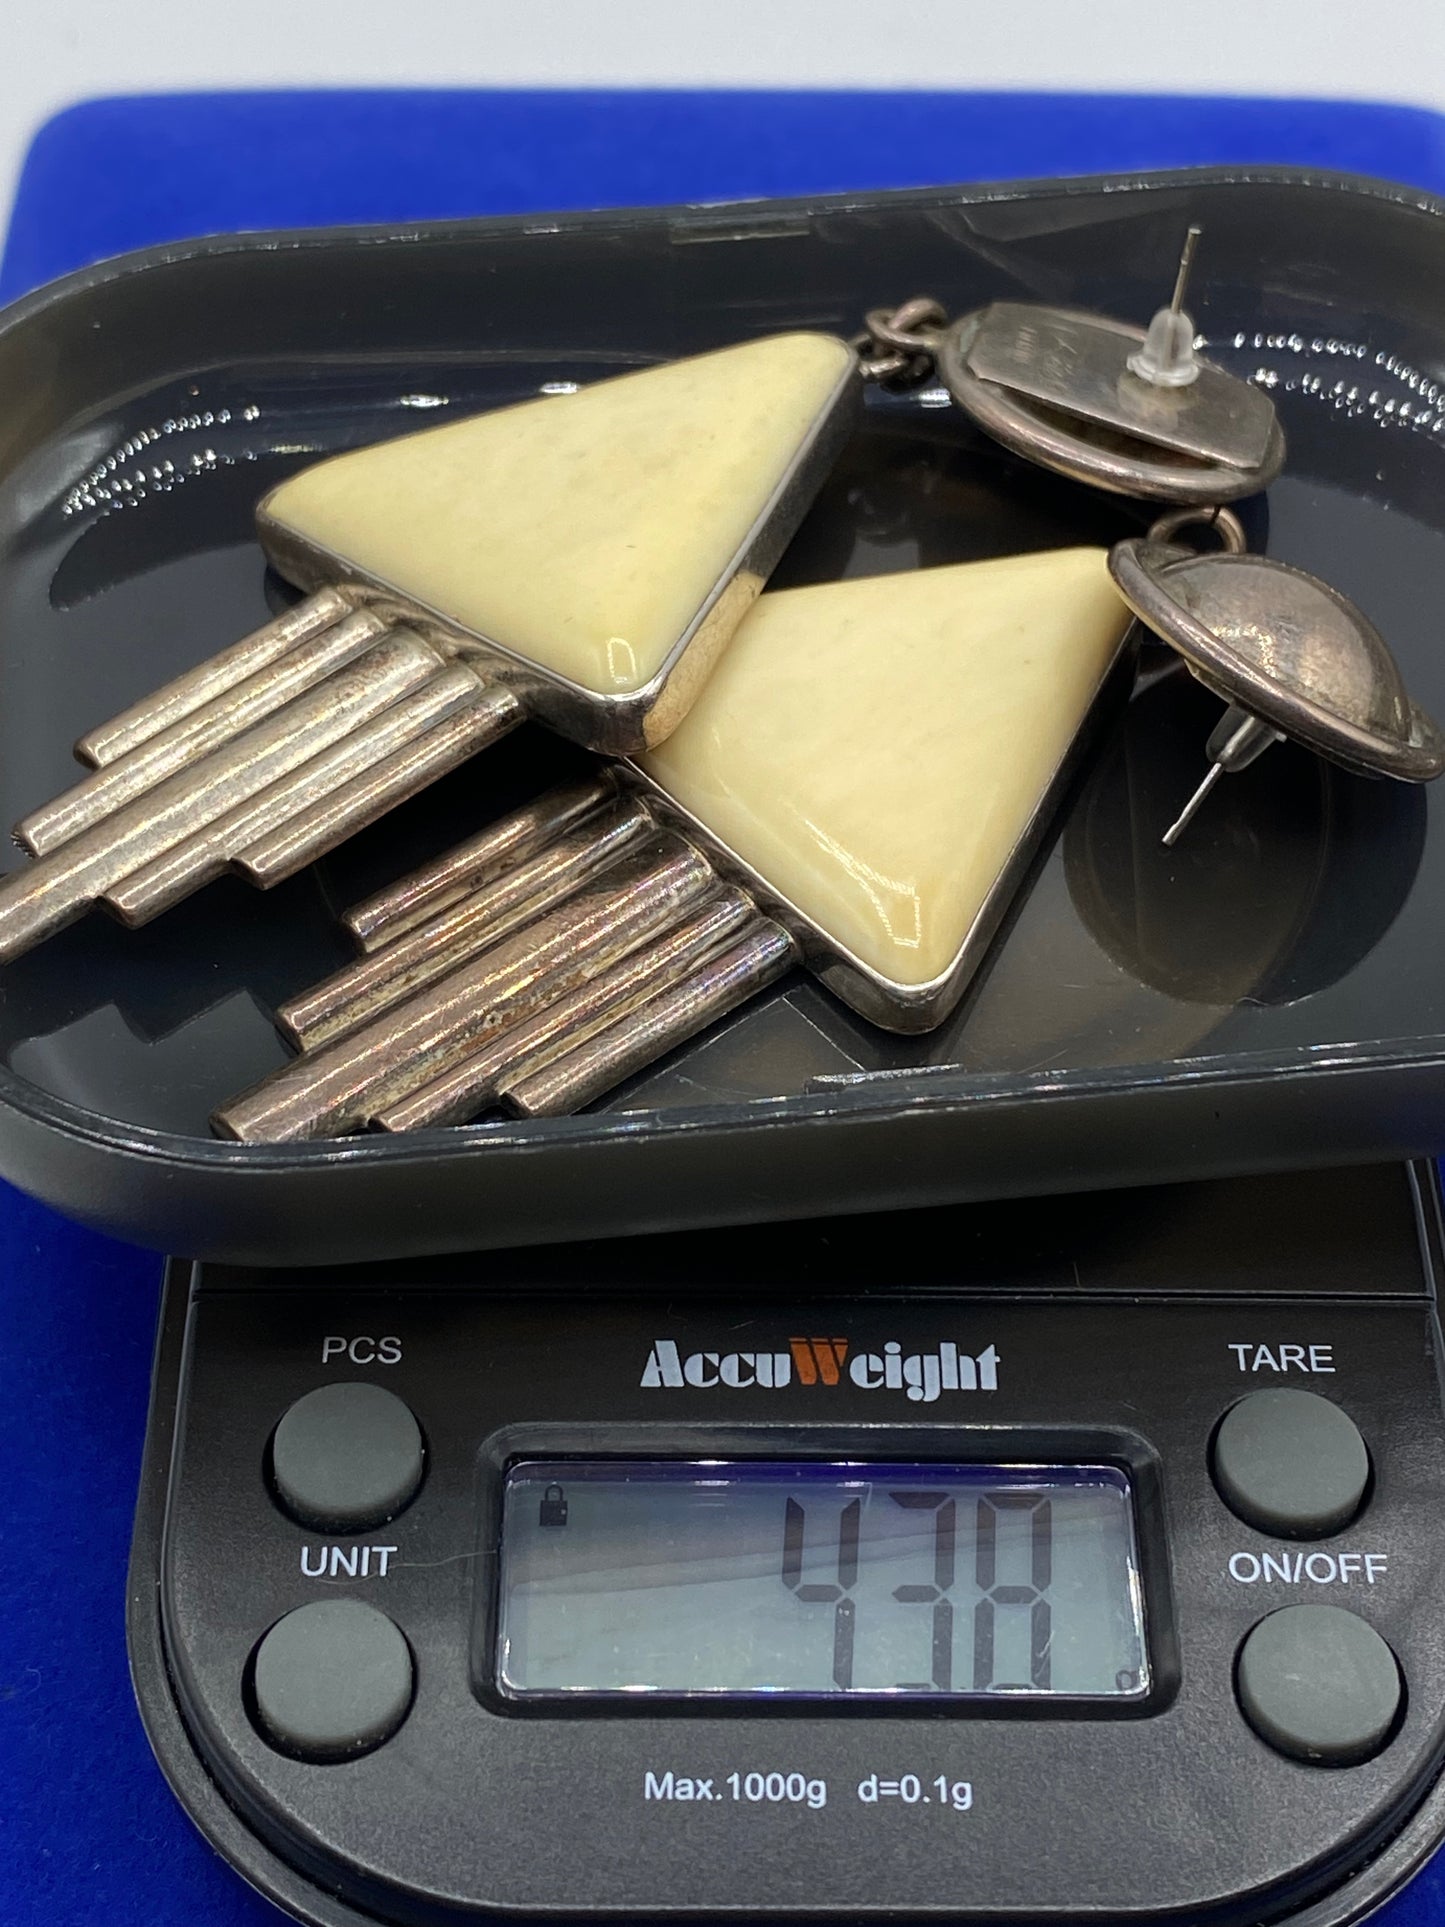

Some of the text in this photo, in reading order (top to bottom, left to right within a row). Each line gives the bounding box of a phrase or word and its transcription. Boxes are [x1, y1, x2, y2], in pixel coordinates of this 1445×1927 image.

[321, 1336, 403, 1364] PCS
[1228, 1343, 1336, 1373] TARE
[640, 1337, 1001, 1402] AccuWeight
[300, 1546, 398, 1577] UNIT
[1228, 1552, 1388, 1584] ON/OFF
[644, 1771, 974, 1811] Max.1000g d=0.1g
